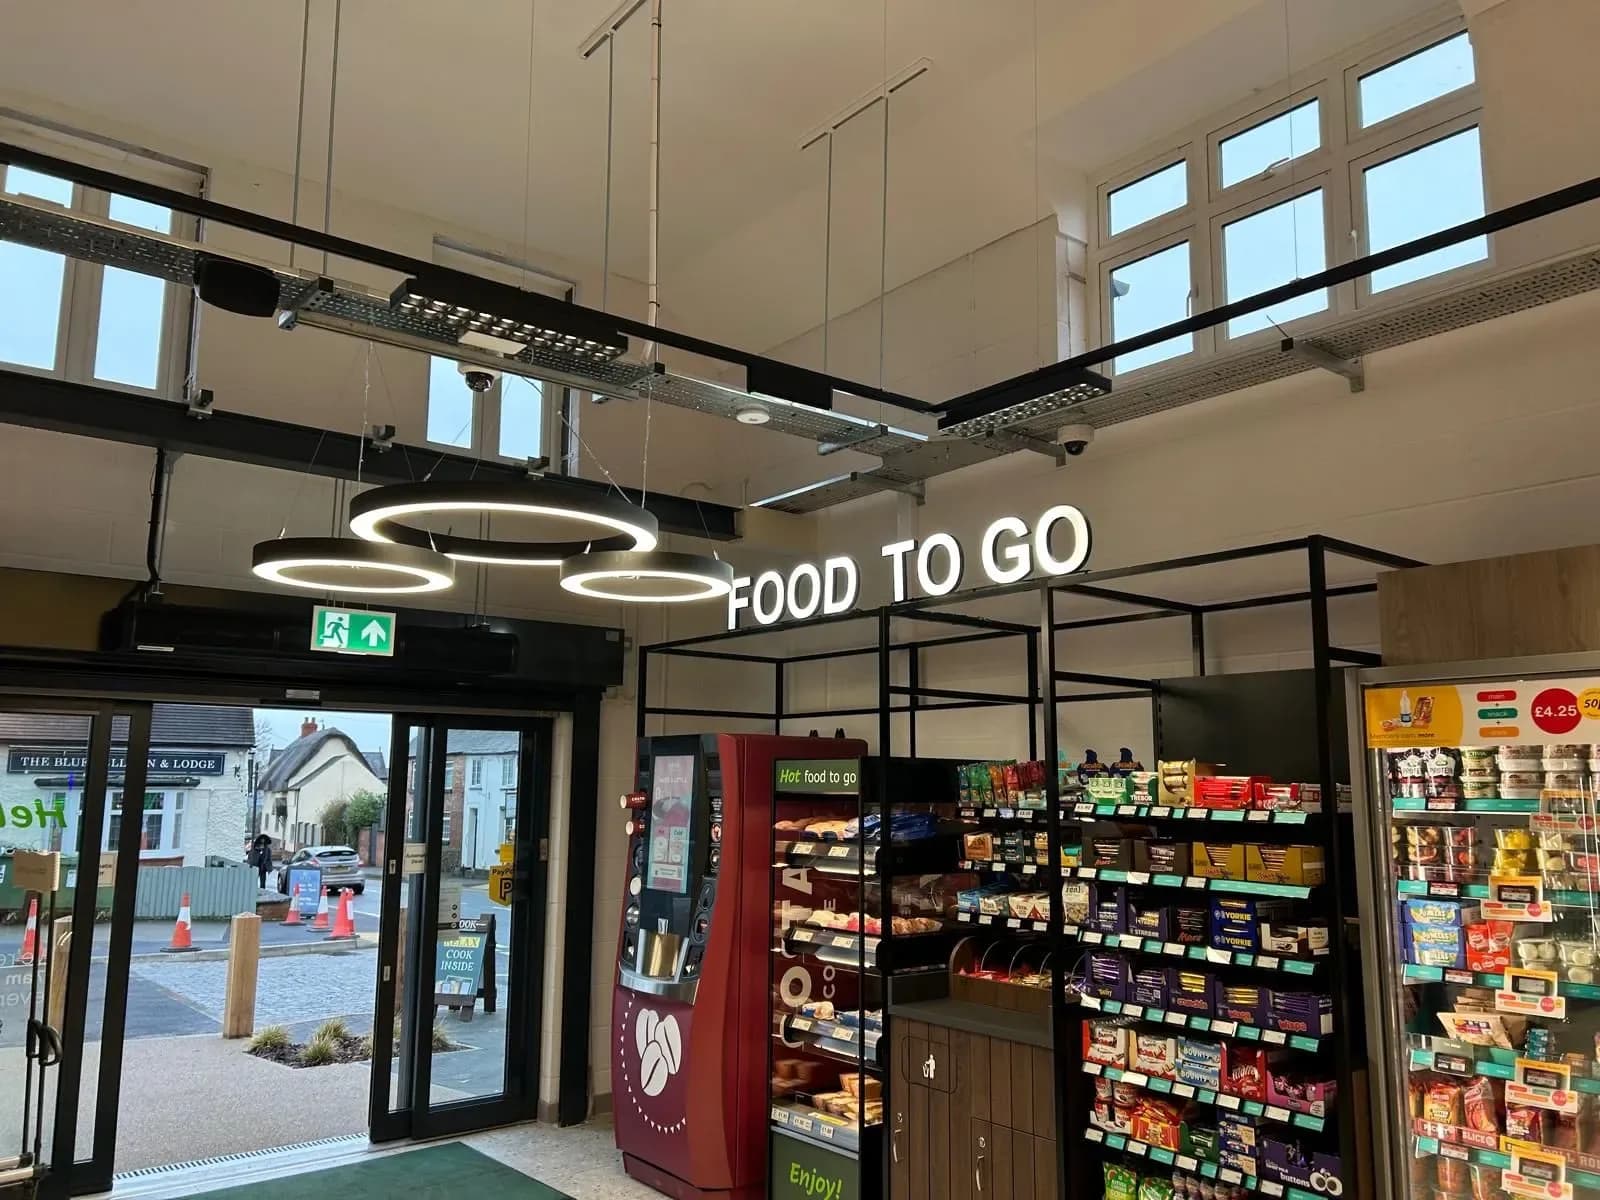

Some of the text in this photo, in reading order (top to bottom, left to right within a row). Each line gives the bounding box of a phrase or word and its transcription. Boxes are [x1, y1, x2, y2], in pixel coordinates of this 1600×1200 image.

[727, 504, 1090, 631] FOOD TO GO
[1534, 705, 1577, 718] £4.25
[20, 756, 50, 767] THE
[159, 759, 169, 769] &
[173, 759, 216, 769] LODGE
[780, 769, 857, 786] Hot food to go
[1224, 911, 1252, 921] YORKIE
[446, 949, 474, 960] COOK
[440, 960, 475, 971] INSIDE
[790, 1162, 842, 1200] Enjoy!
[1280, 1172, 1311, 1188] buttons
